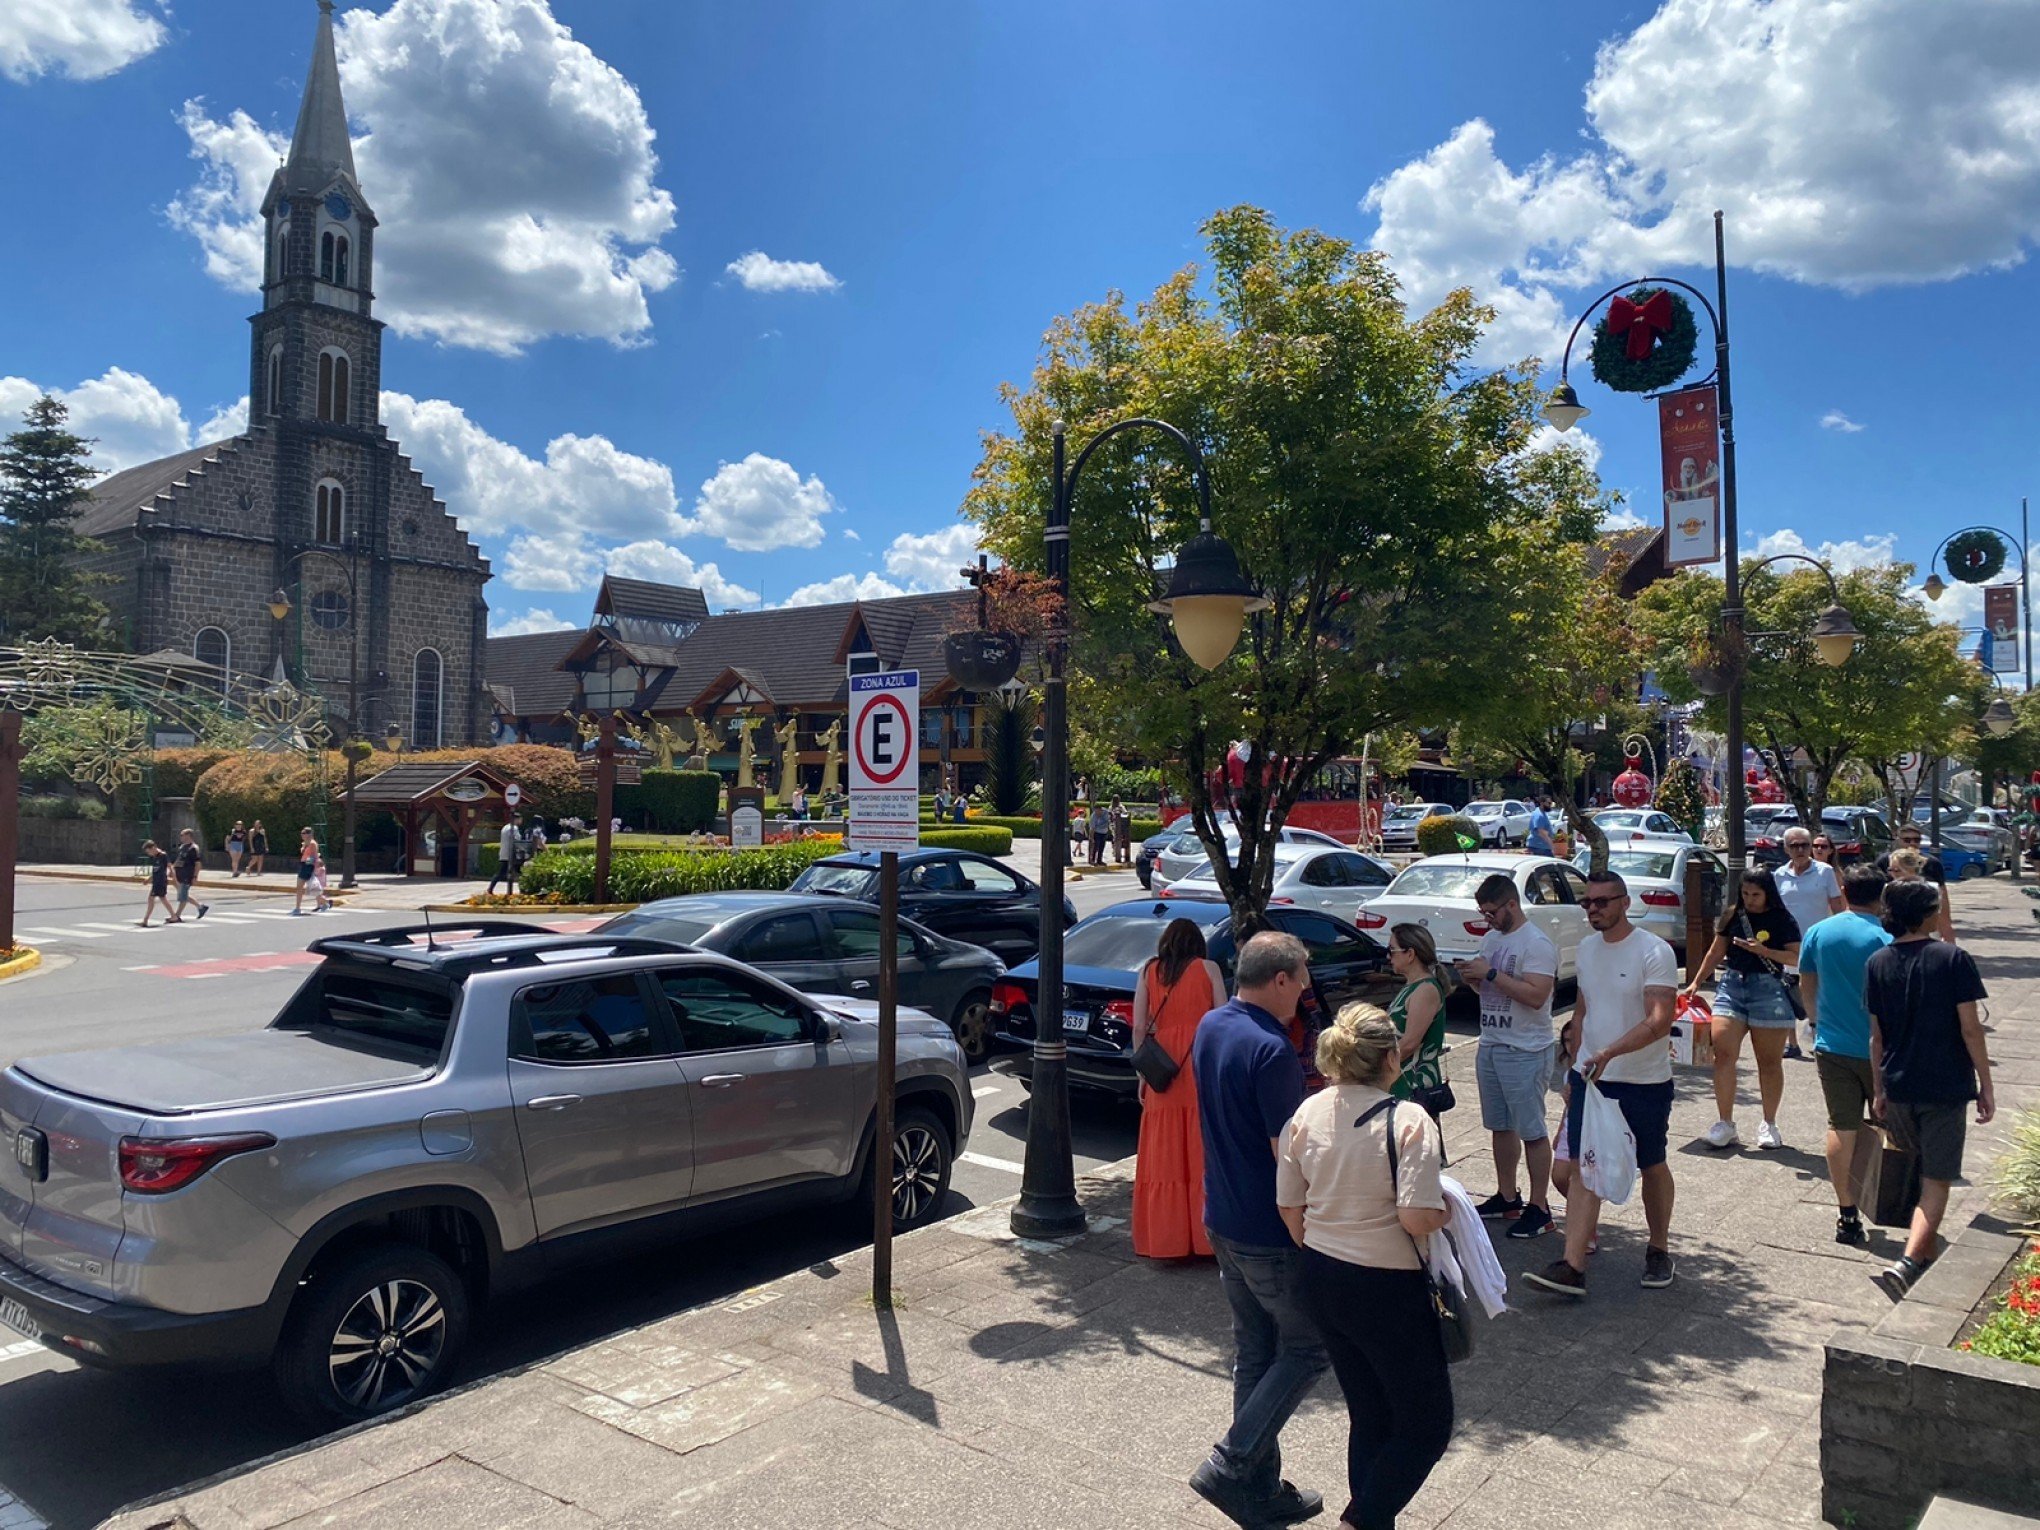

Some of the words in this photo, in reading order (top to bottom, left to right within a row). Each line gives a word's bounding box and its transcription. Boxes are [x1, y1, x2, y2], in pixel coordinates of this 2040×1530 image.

[861, 678, 884, 689] ZONA
[885, 676, 907, 687] AZUL
[873, 713, 893, 764] E
